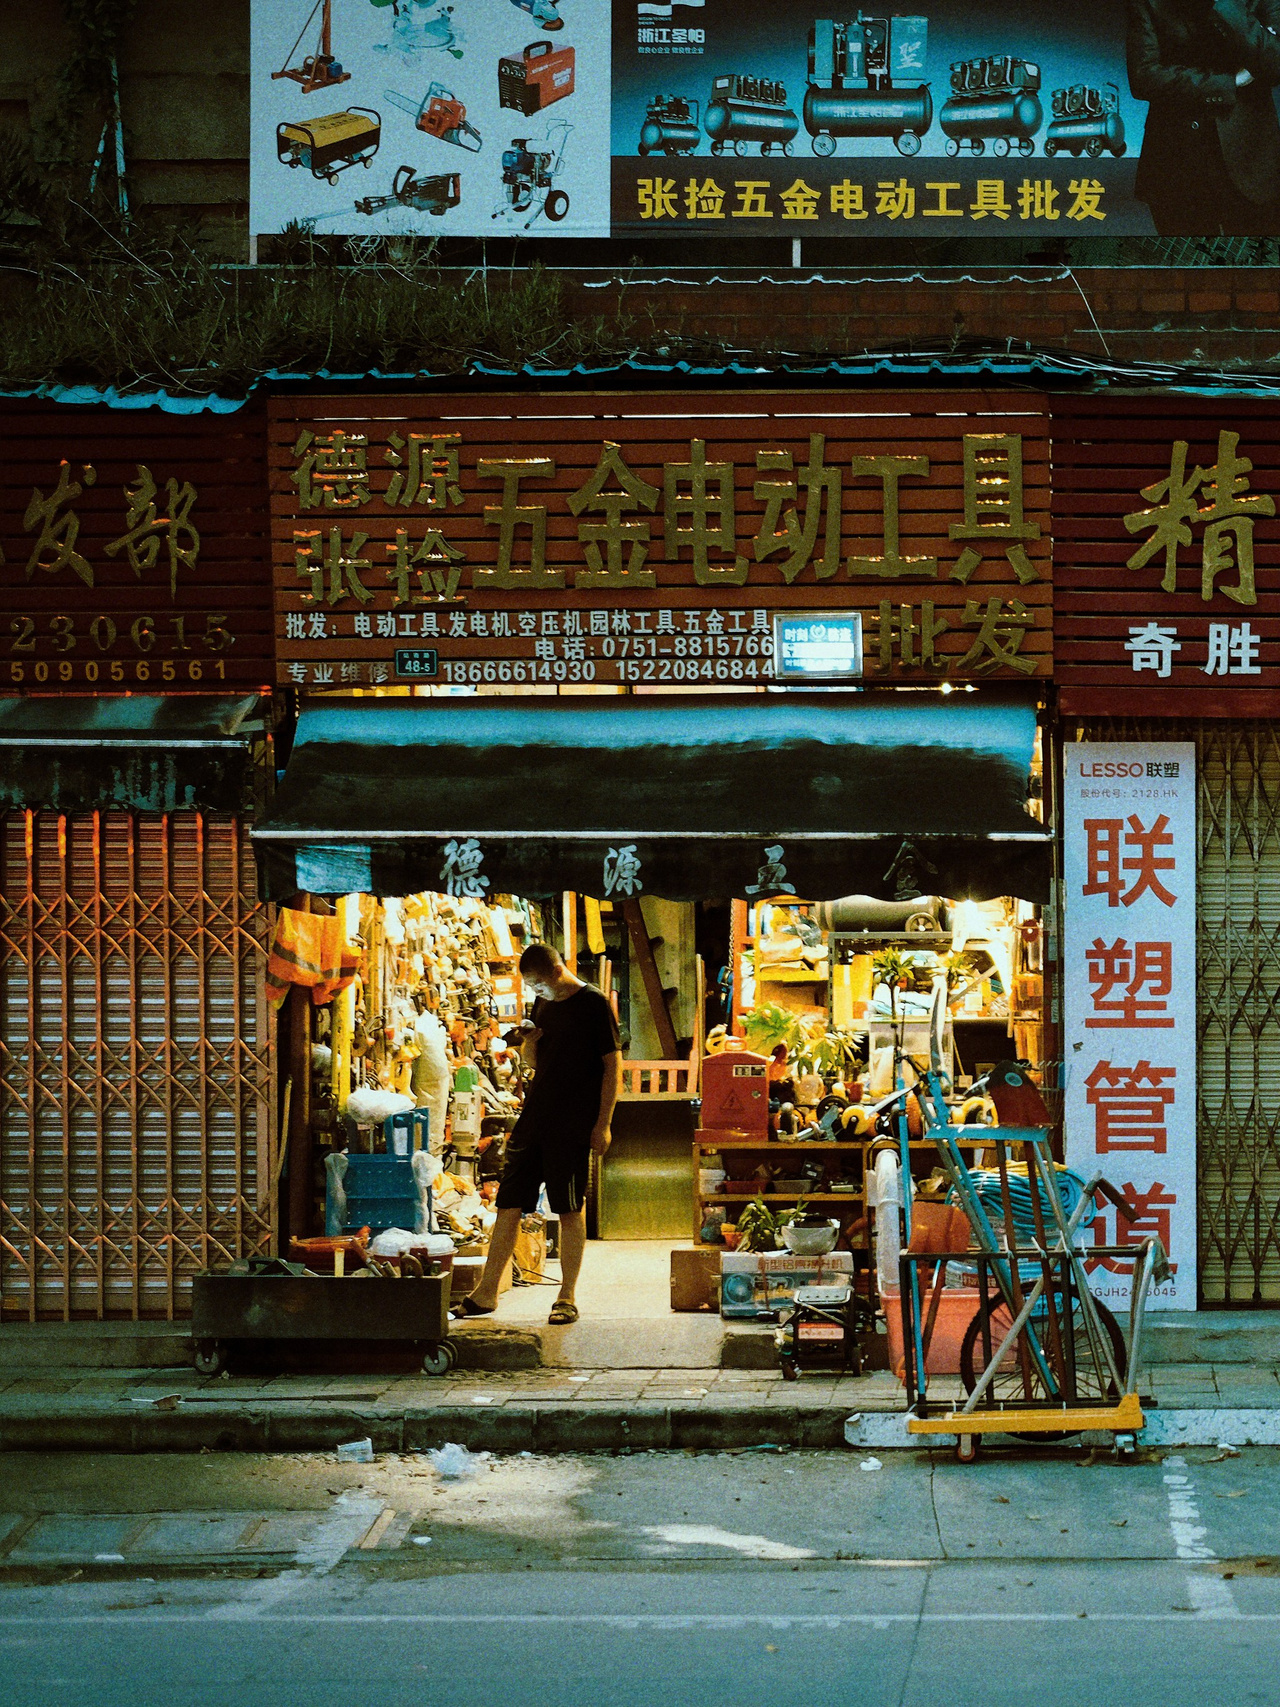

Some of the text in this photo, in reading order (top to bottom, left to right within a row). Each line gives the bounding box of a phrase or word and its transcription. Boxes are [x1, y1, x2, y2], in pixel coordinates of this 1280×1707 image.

[638, 28, 705, 43] 浙江圣帕
[637, 178, 1107, 221] 张捡五金电动工具批发
[290, 429, 463, 511] 德源
[473, 432, 1042, 590] 五金电动工具
[0, 458, 201, 602] 发部
[293, 527, 468, 606] 张捡
[602, 636, 774, 657] 0751-8815766
[870, 598, 1039, 676] 批发
[10, 661, 226, 681] 509056561
[287, 662, 389, 683] 专业维修
[405, 660, 430, 672] 48-5
[443, 661, 596, 682] 18666614930
[616, 660, 775, 681] 15220846844
[1080, 762, 1180, 778] LESSO 联塑
[1132, 789, 1179, 798] 2128.HK
[1082, 813, 1179, 1276] 联塑管道
